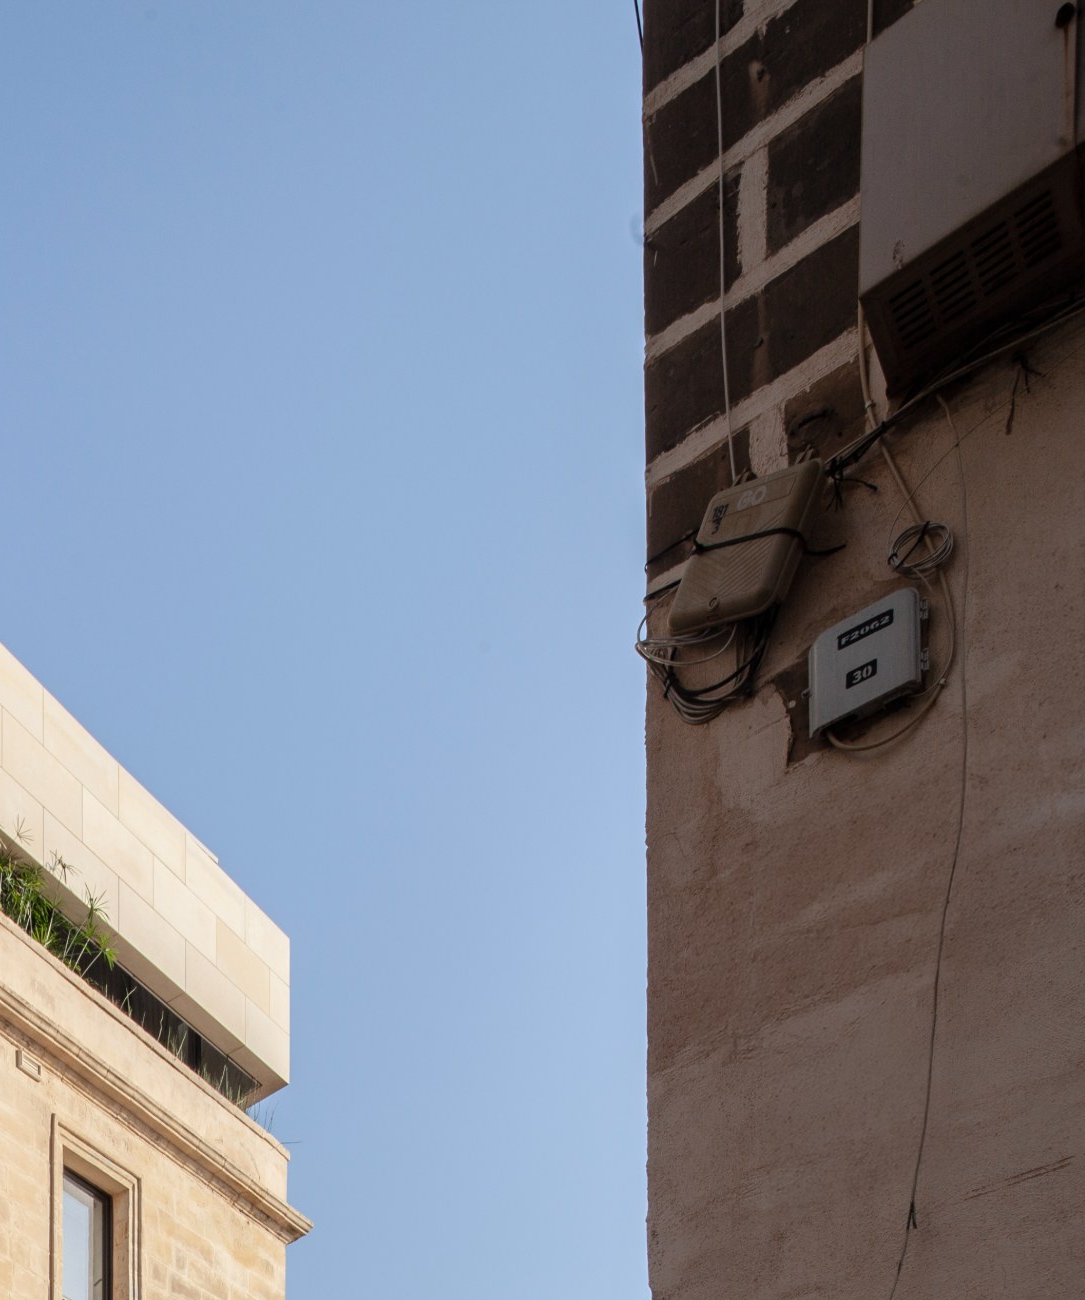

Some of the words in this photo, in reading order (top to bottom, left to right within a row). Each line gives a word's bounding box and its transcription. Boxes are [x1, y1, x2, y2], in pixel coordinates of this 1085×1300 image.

[737, 485, 767, 511] GO
[840, 615, 890, 646] F2062
[852, 665, 873, 684] 30
